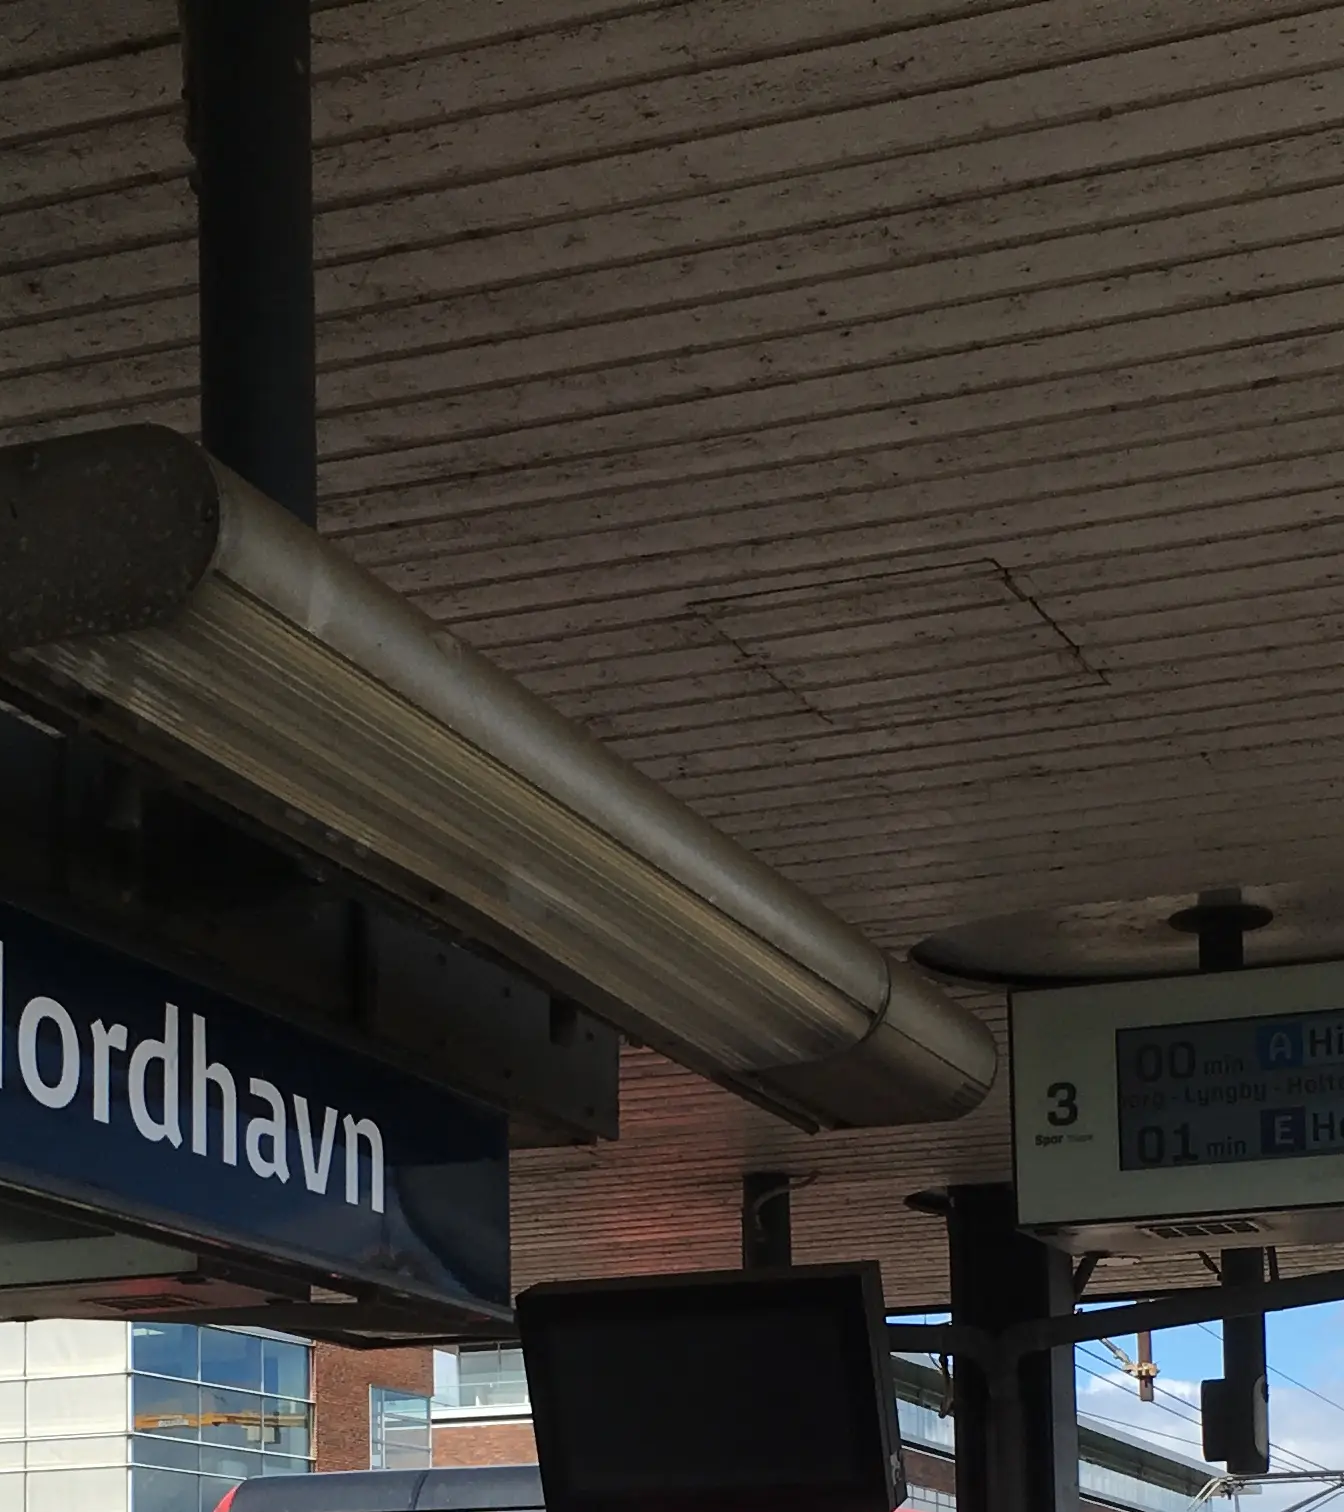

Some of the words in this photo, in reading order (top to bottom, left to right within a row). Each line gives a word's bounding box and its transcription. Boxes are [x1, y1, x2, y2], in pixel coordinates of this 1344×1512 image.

[1136, 1041, 1197, 1082] 00
[1203, 1054, 1244, 1077] min
[1268, 1031, 1293, 1061] A
[1047, 1082, 1078, 1126] 3
[1137, 1121, 1199, 1164] 01
[1206, 1135, 1248, 1158] min
[1274, 1114, 1295, 1145] E
